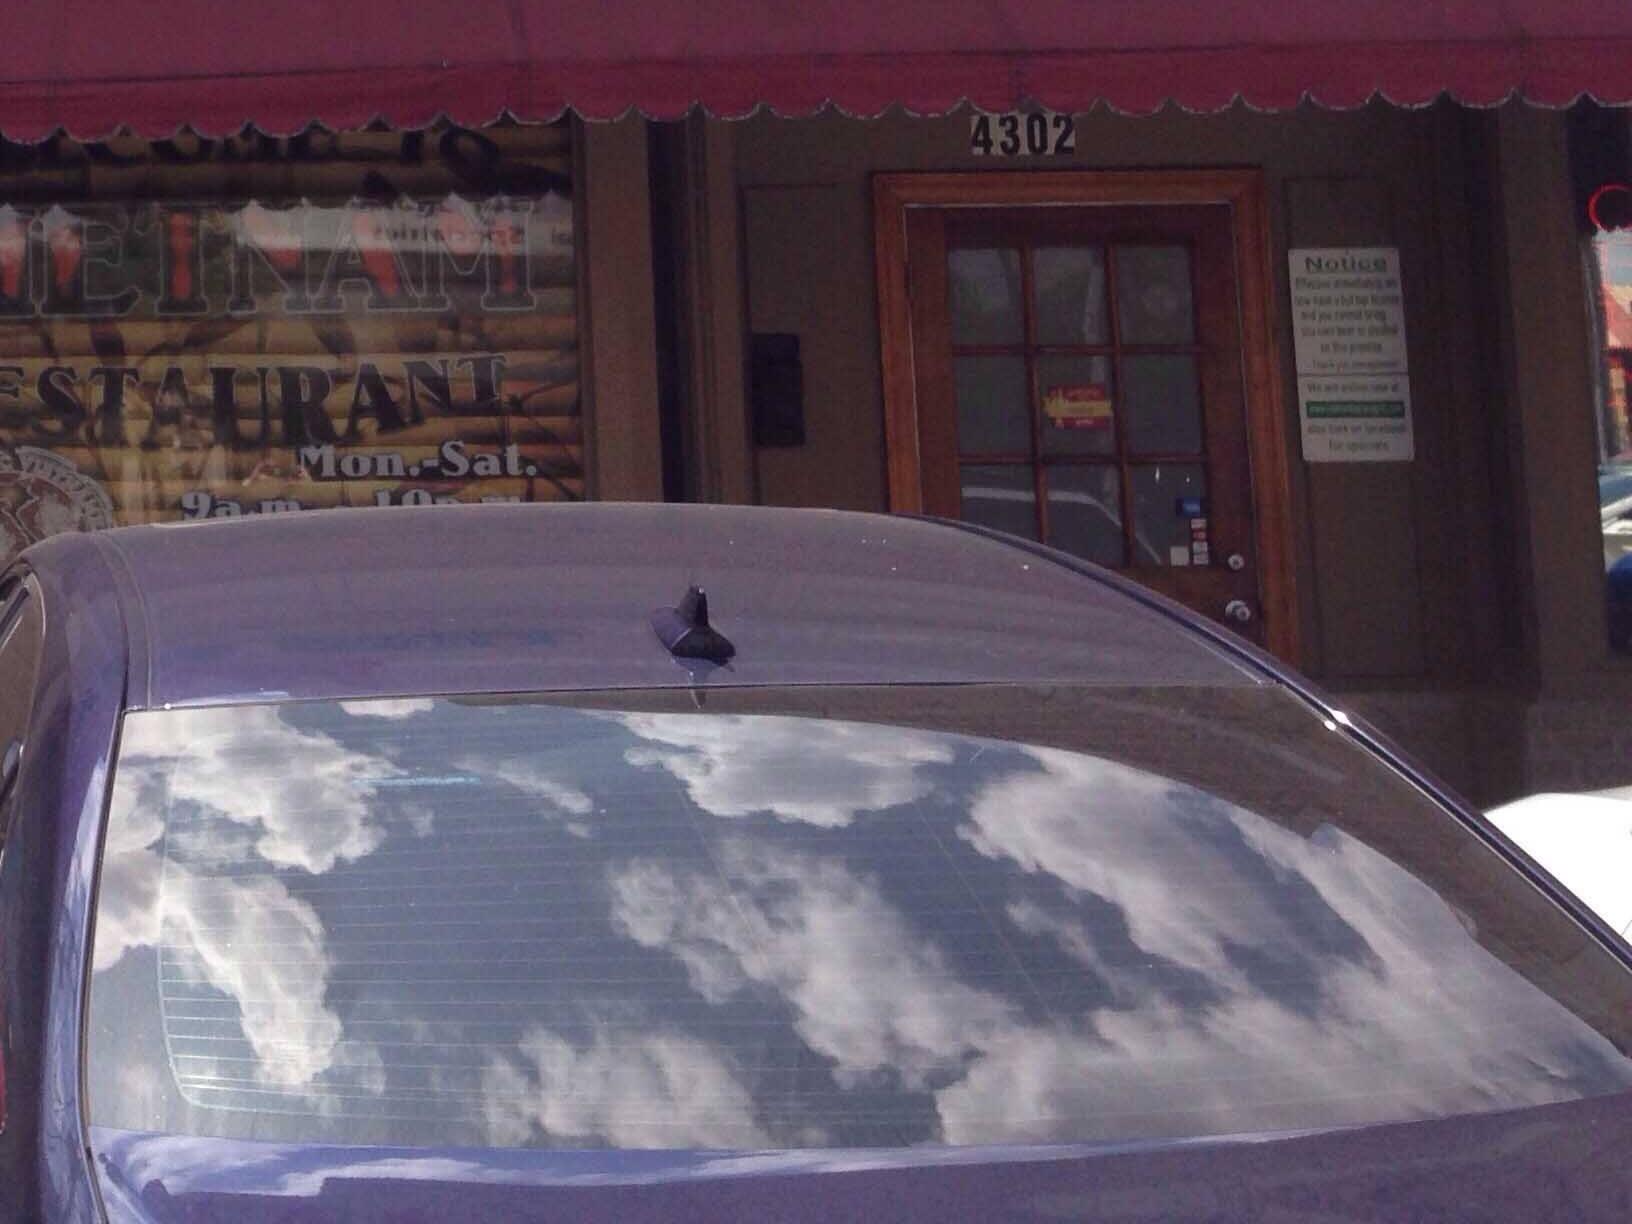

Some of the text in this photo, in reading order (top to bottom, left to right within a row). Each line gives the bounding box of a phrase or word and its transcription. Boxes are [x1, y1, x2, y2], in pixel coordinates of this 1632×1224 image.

[971, 112, 1074, 154] 4302
[1304, 256, 1387, 273] Notice
[299, 440, 537, 477] Mon.-Sat.
